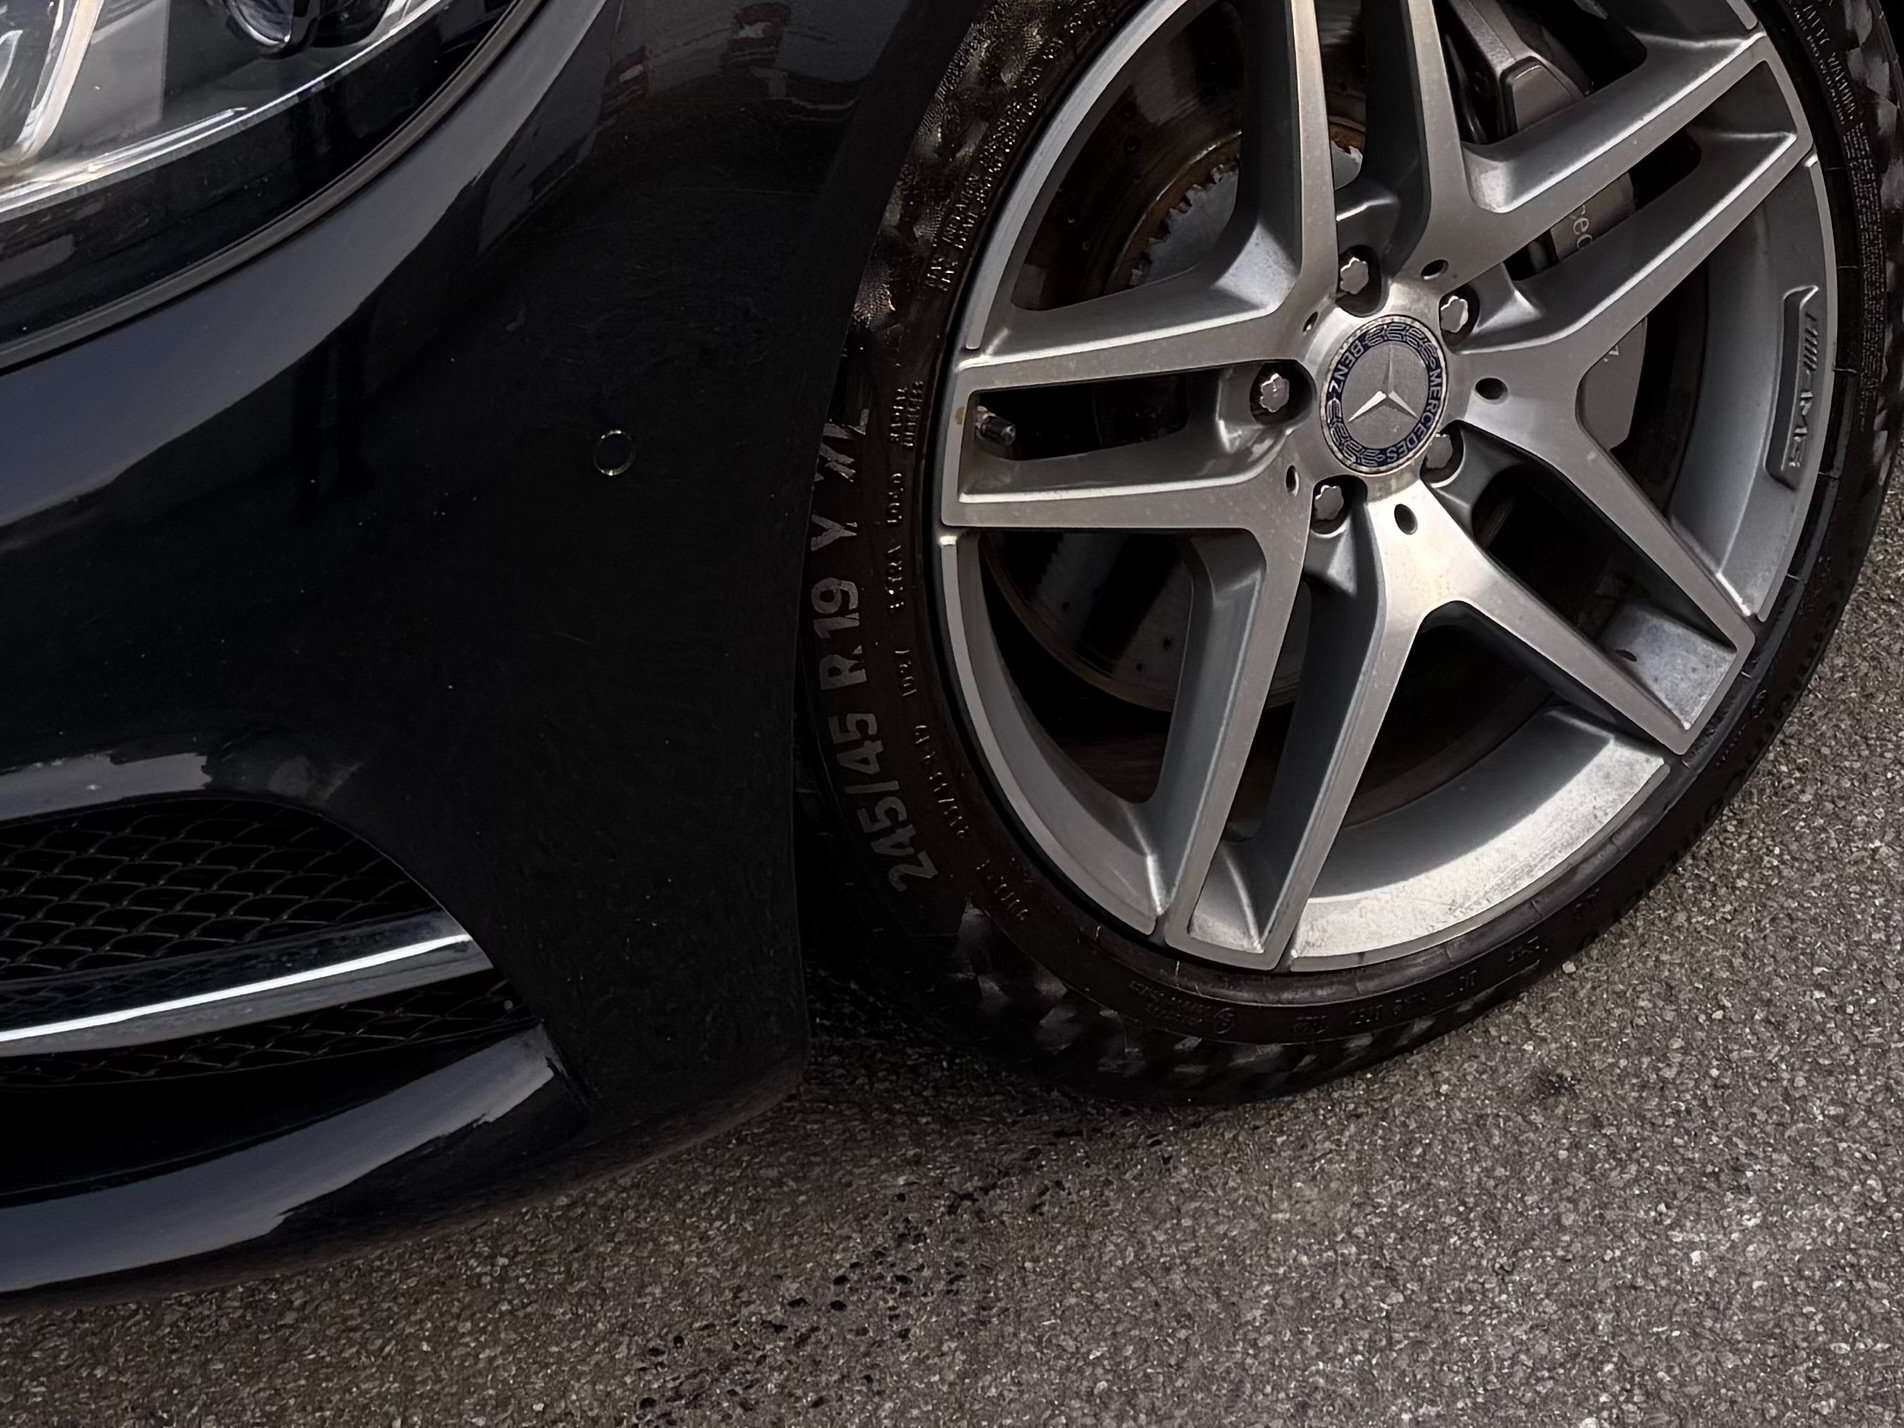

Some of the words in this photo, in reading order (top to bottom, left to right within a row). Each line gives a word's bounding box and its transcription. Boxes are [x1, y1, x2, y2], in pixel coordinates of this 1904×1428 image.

[1328, 341, 1365, 393] BENZ
[1386, 368, 1443, 463] MERCEDES
[827, 712, 939, 893] 245/45
